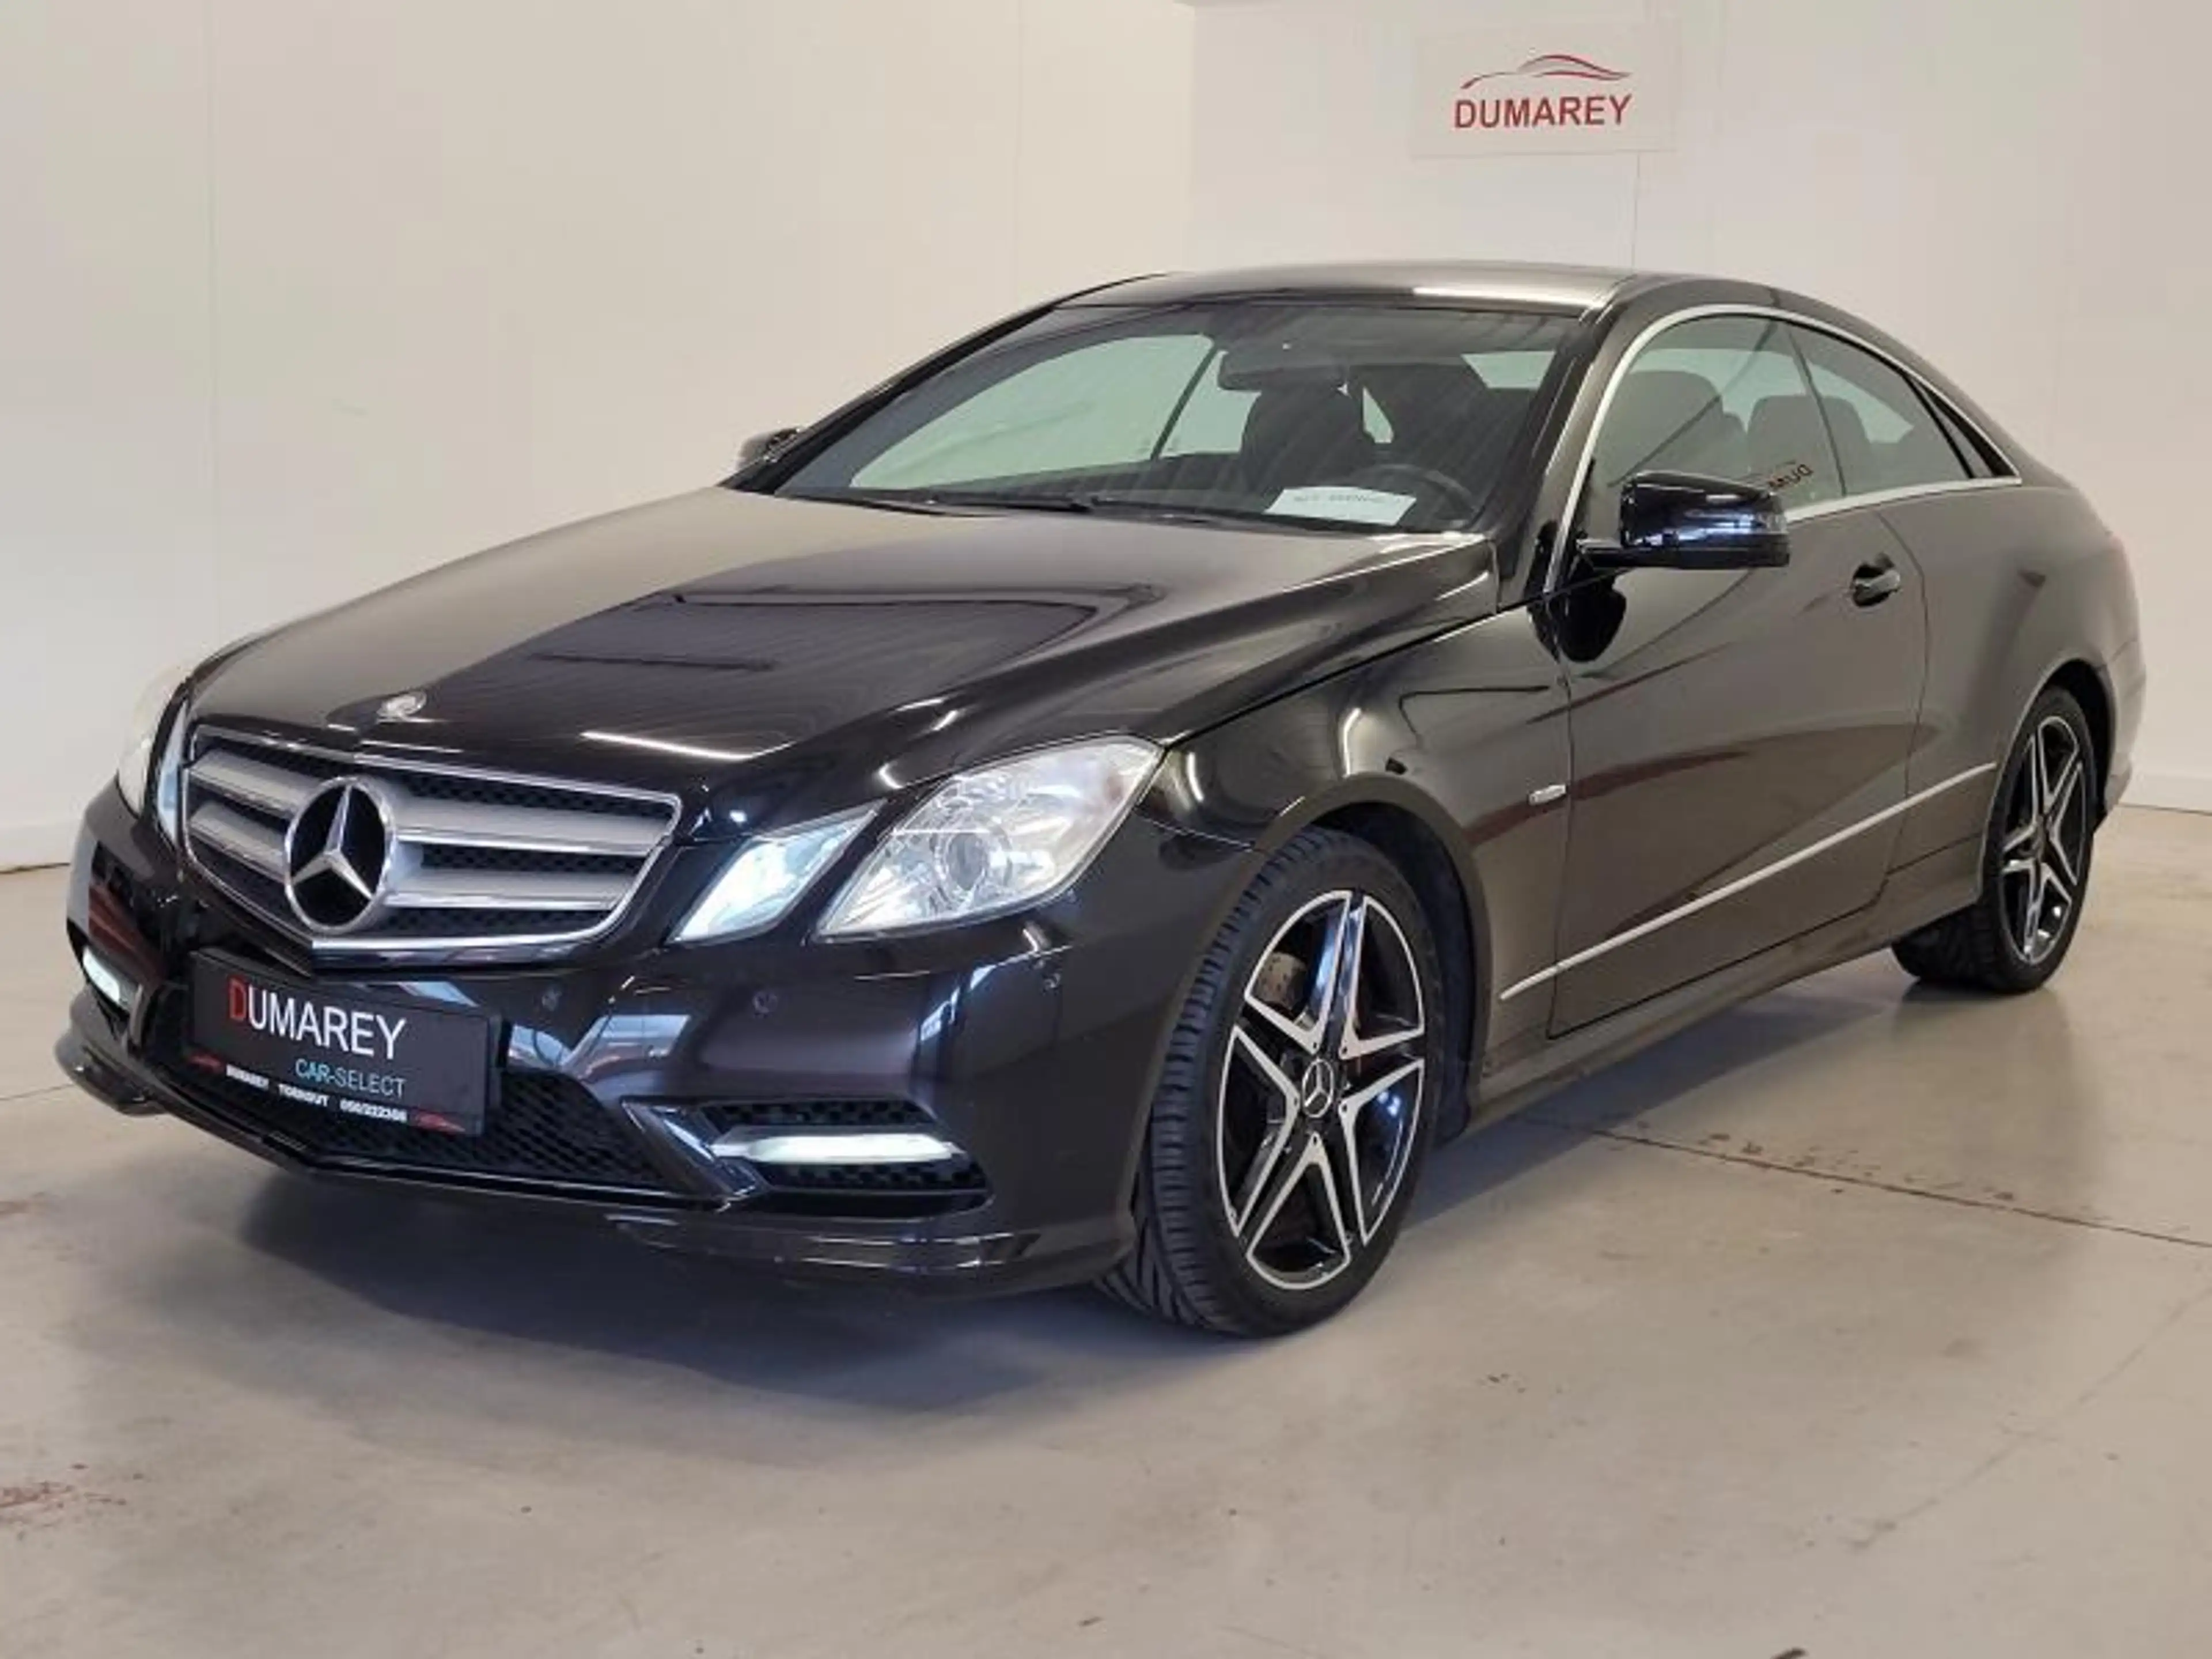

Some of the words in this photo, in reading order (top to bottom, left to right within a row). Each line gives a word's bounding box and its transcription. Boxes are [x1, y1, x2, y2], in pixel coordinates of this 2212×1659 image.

[1455, 94, 1632, 128] DUMAREY
[228, 974, 406, 1059] DUMAREY
[296, 1058, 406, 1099] CAR-SELECT
